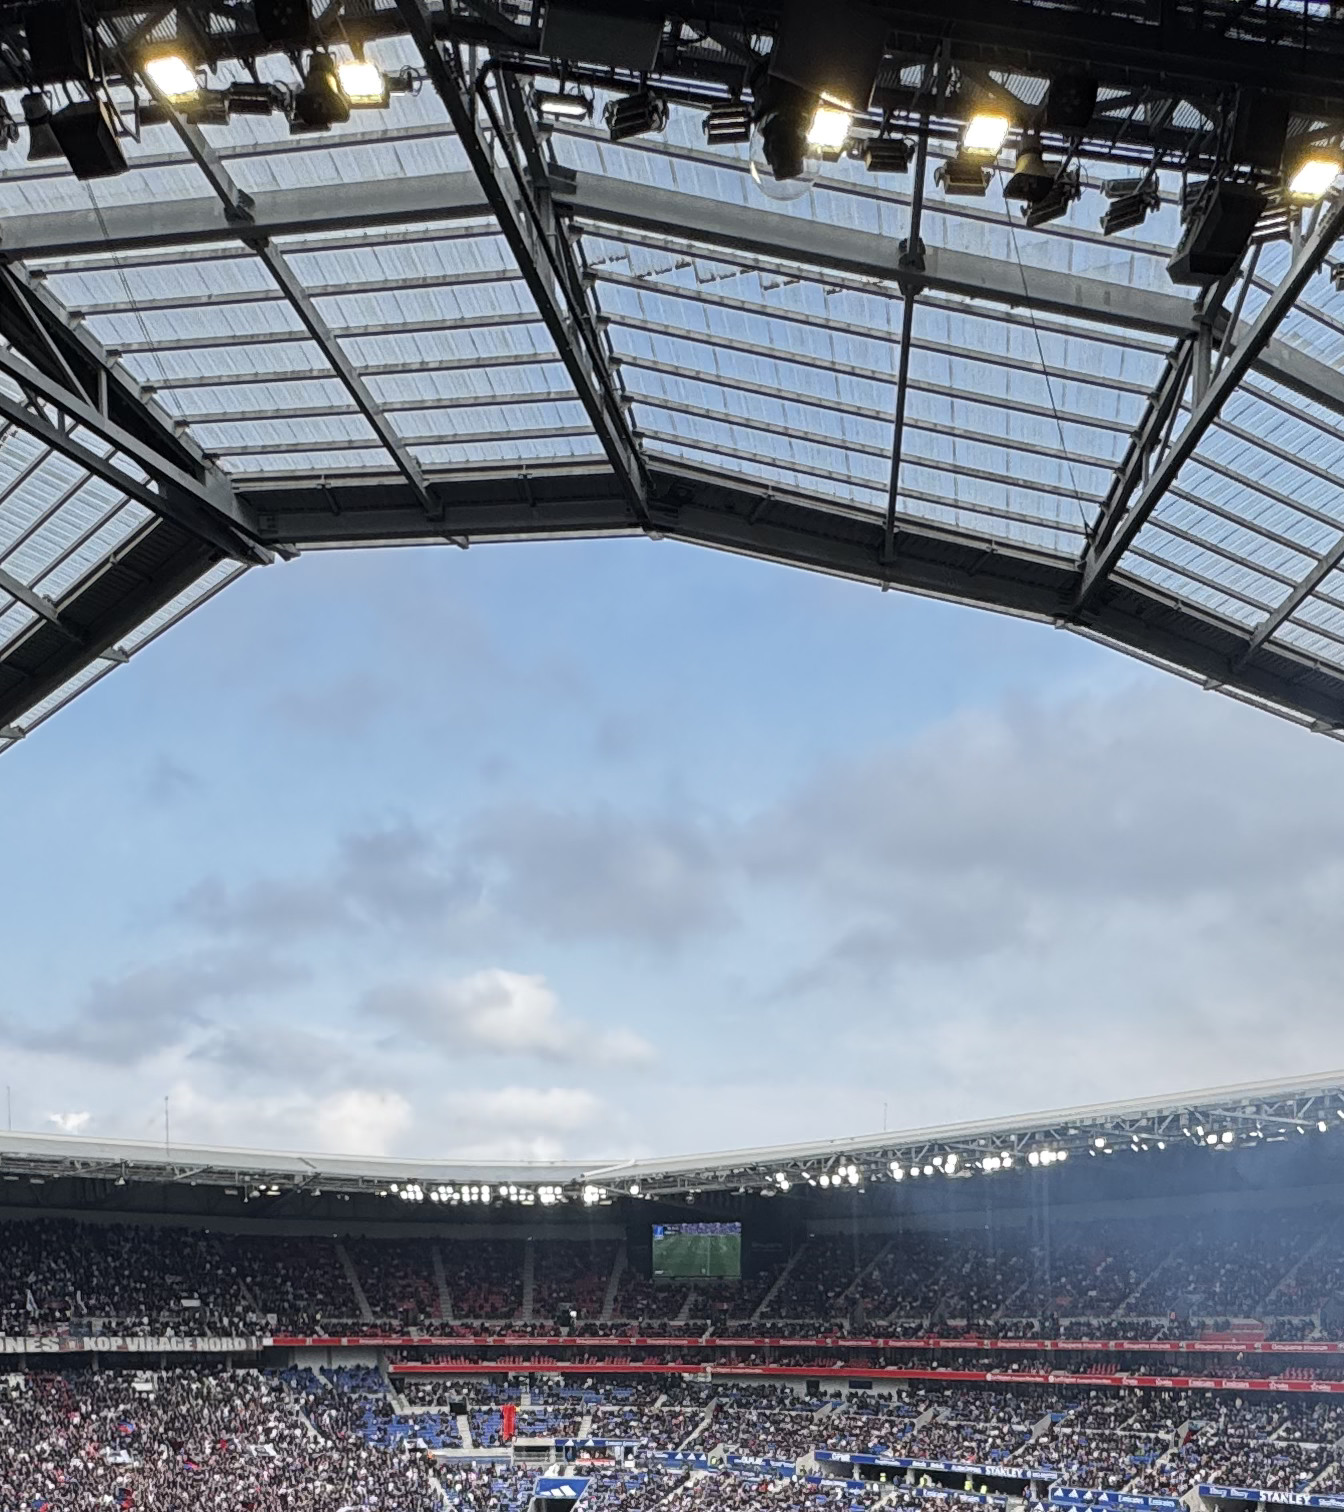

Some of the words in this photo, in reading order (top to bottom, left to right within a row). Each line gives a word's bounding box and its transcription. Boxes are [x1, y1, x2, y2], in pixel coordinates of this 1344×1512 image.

[83, 1336, 123, 1351] KOP
[126, 1336, 193, 1351] VIRAGE
[196, 1336, 247, 1351] NORD
[1259, 1490, 1310, 1505] STANLEY
